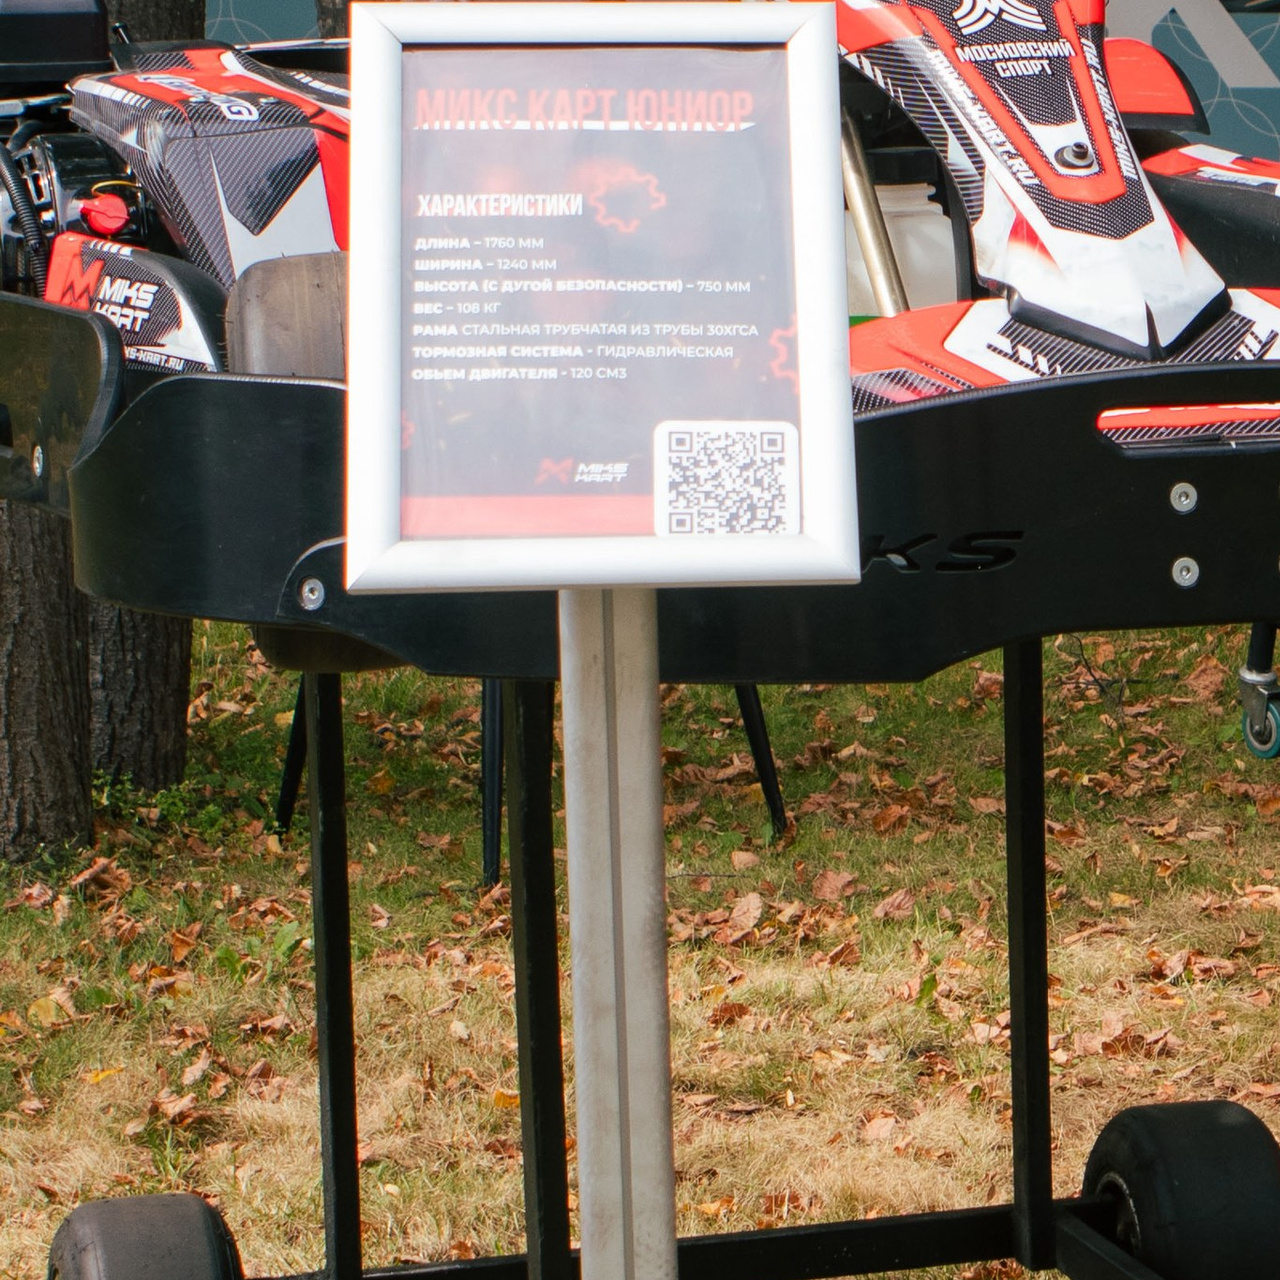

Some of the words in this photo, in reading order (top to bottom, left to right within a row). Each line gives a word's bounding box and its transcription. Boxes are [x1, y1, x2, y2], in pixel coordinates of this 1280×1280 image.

[955, 39, 1076, 62] МОСКОВСКИЙ
[995, 60, 1052, 78] СПОРТ
[416, 88, 518, 130] МИКС
[528, 88, 617, 130] КАРТ
[626, 88, 754, 132] ЮНИОР
[418, 193, 583, 217] ХАРАКТЕРИСТИКИ
[415, 237, 470, 251] ДЛИНА
[485, 237, 515, 250] 1760
[519, 237, 544, 250] ММ
[414, 259, 483, 271] ШИРИНА
[497, 259, 528, 271] 1240
[532, 259, 557, 271] ММ
[99, 276, 159, 309] MIKS
[414, 280, 479, 293] ВЫСОТА
[482, 280, 498, 294] (С
[502, 278, 552, 294] ДУГОЙ
[556, 278, 683, 294] БЕЗОПАСНОСТИ)
[697, 281, 722, 293] 750
[726, 281, 751, 293] ММ
[413, 302, 443, 315] ВЕС
[457, 302, 481, 314] 108
[484, 302, 501, 314] КГ
[412, 324, 458, 336] РАМА
[462, 324, 540, 336] СТАЛЬНАЯ
[543, 324, 626, 336] ТРУБЧАТАЯ
[631, 324, 650, 336] ИЗ
[654, 324, 703, 337] ТРУБЫ
[412, 346, 507, 359] ТОРМОЗНАЯ
[510, 346, 583, 358] СИСТЕМА
[597, 346, 734, 359] ГИДРАВЛИЧЕСКАЯ
[469, 368, 557, 382] ДВИГАТЕЛЯ
[571, 368, 593, 379] 120
[596, 368, 628, 380] СМ3
[578, 463, 629, 472] MIKS
[575, 473, 627, 483] KART
[862, 530, 1025, 573] KS
